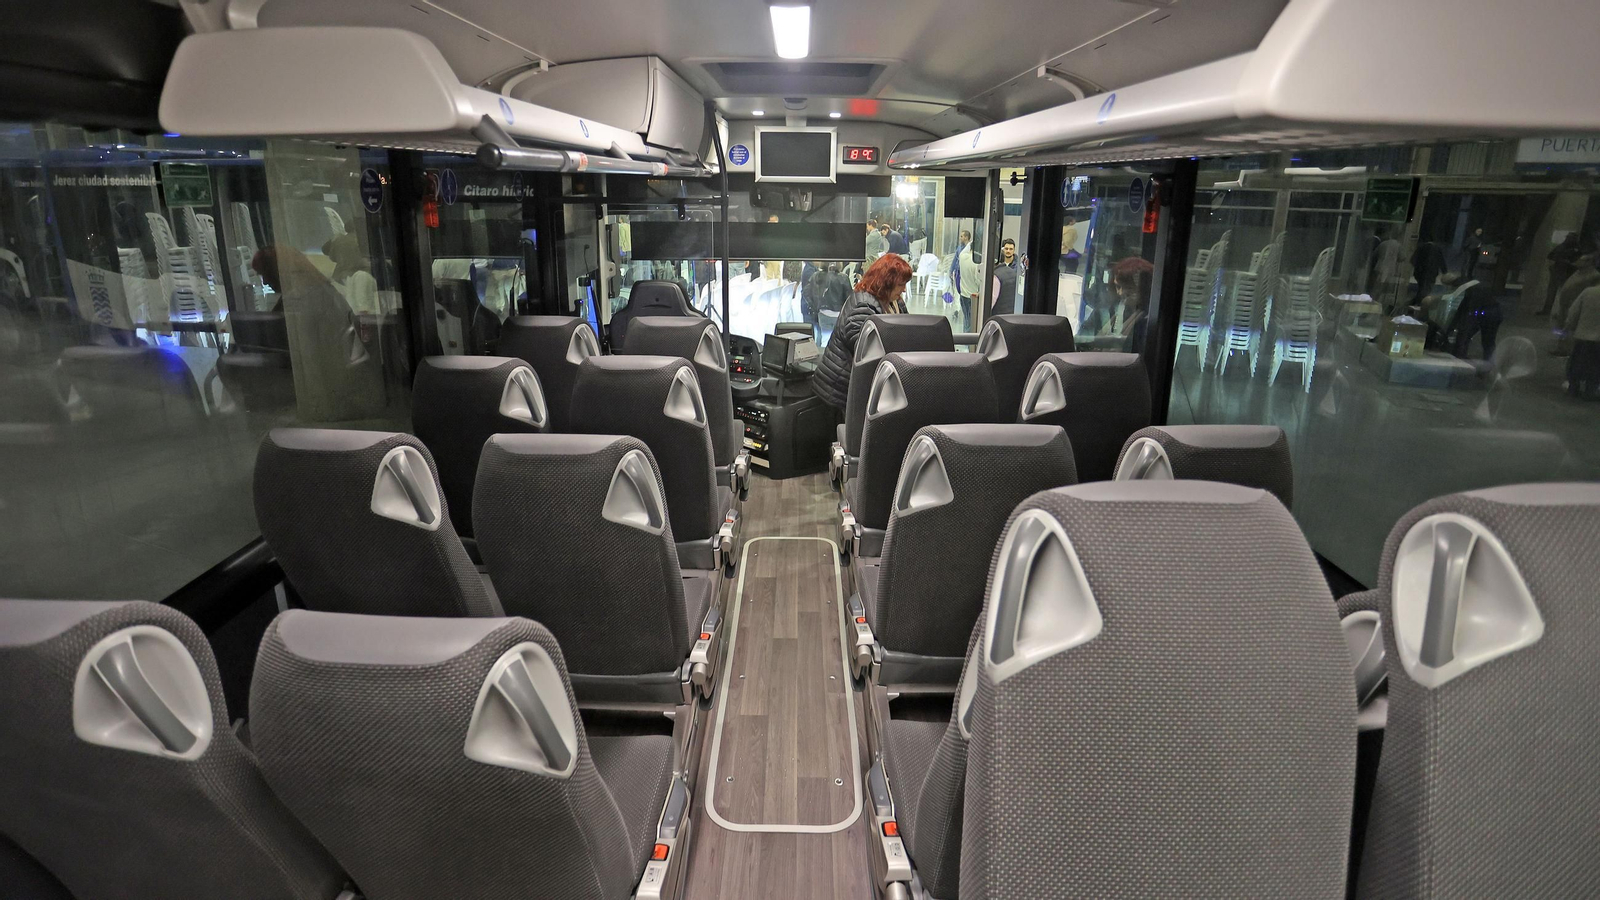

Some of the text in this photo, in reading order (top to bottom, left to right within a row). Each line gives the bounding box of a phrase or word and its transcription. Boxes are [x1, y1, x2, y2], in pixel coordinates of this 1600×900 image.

[1541, 137, 1600, 152] PUERT
[53, 174, 76, 186] Jerez
[78, 174, 108, 186] ciudad
[109, 174, 157, 187] sostenible
[463, 184, 499, 197] Citaro
